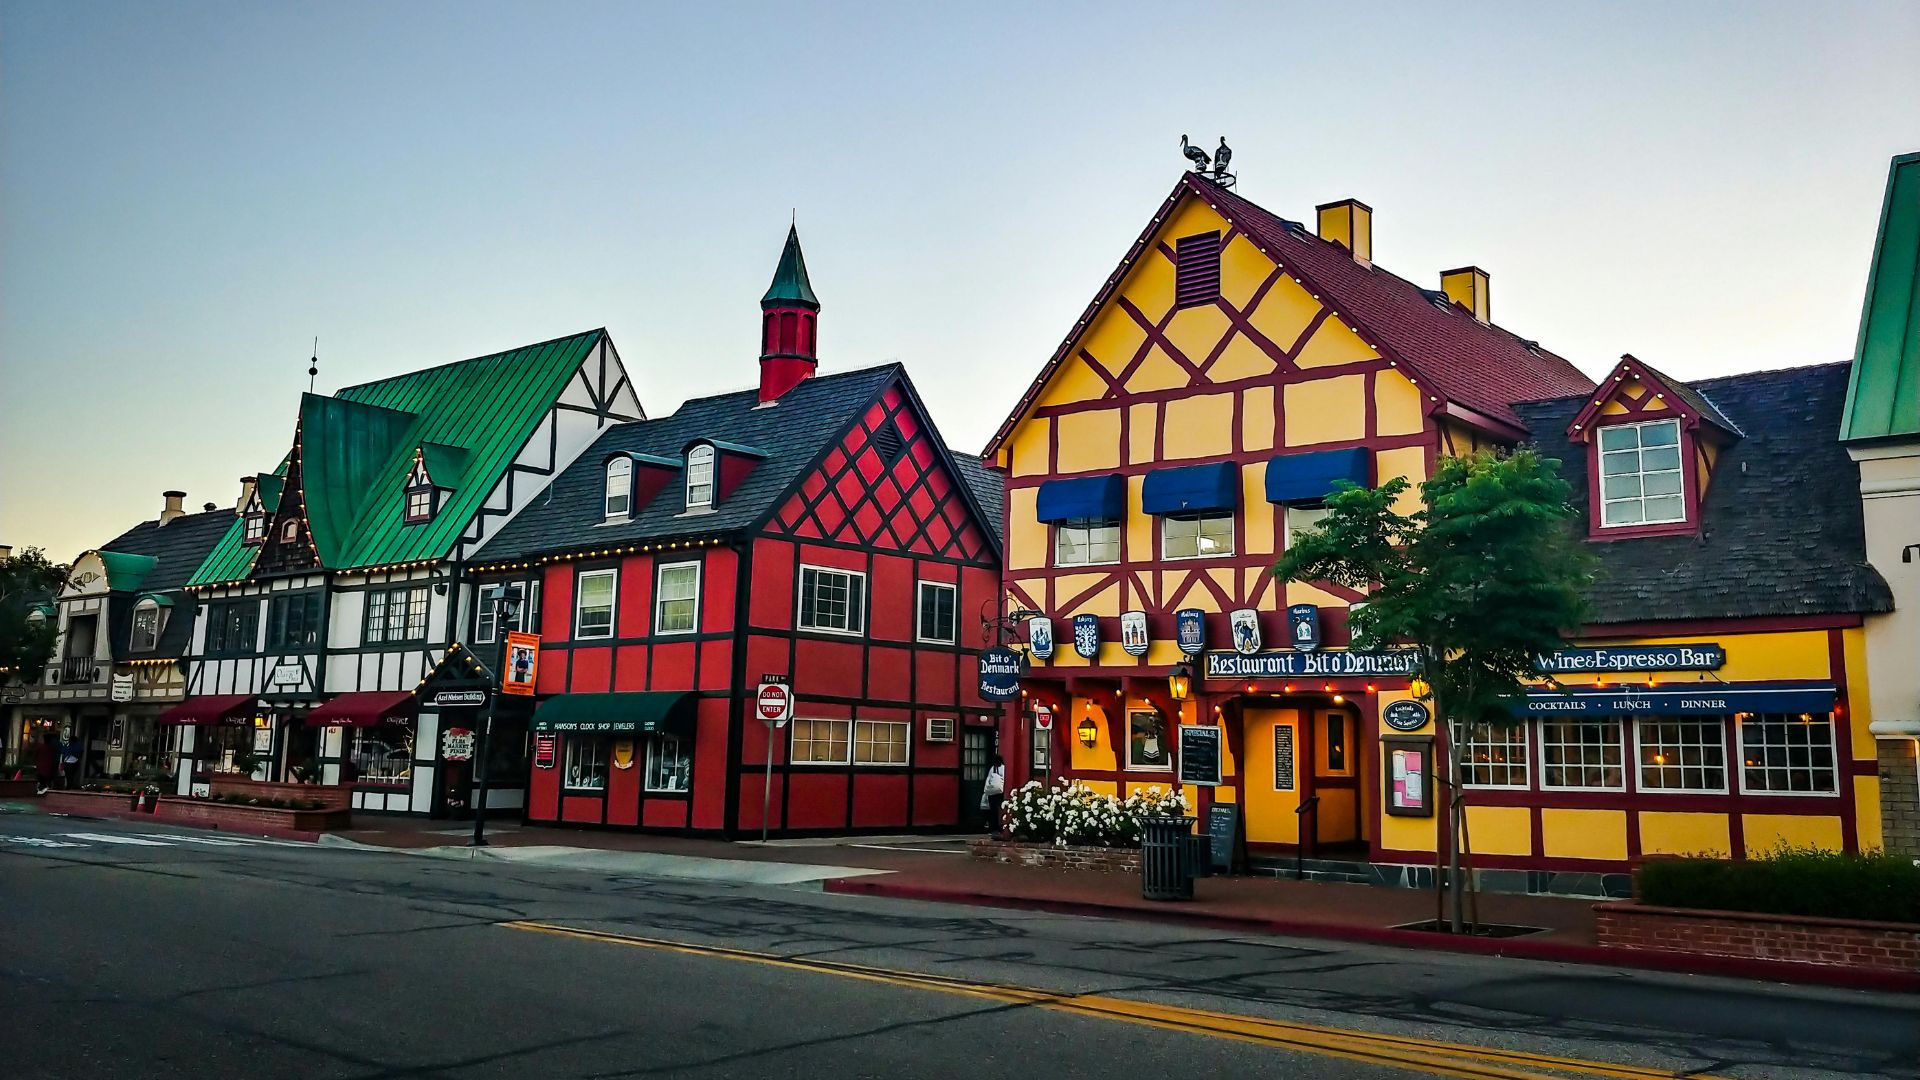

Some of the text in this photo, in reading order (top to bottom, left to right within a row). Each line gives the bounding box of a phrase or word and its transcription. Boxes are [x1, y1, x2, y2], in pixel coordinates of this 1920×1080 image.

[989, 653, 1002, 663] Bit
[1209, 654, 1294, 674] Restaurant
[1304, 654, 1329, 673] Bit
[1680, 648, 1714, 666] Bar
[980, 659, 1019, 674] Denmark
[980, 680, 1020, 695] Restaurant
[1528, 700, 1727, 710] COCKTAILS LUNCH DINNER
[580, 722, 596, 730] CLOCK
[598, 722, 610, 730] SHOP
[613, 722, 635, 730] JEWELERS
